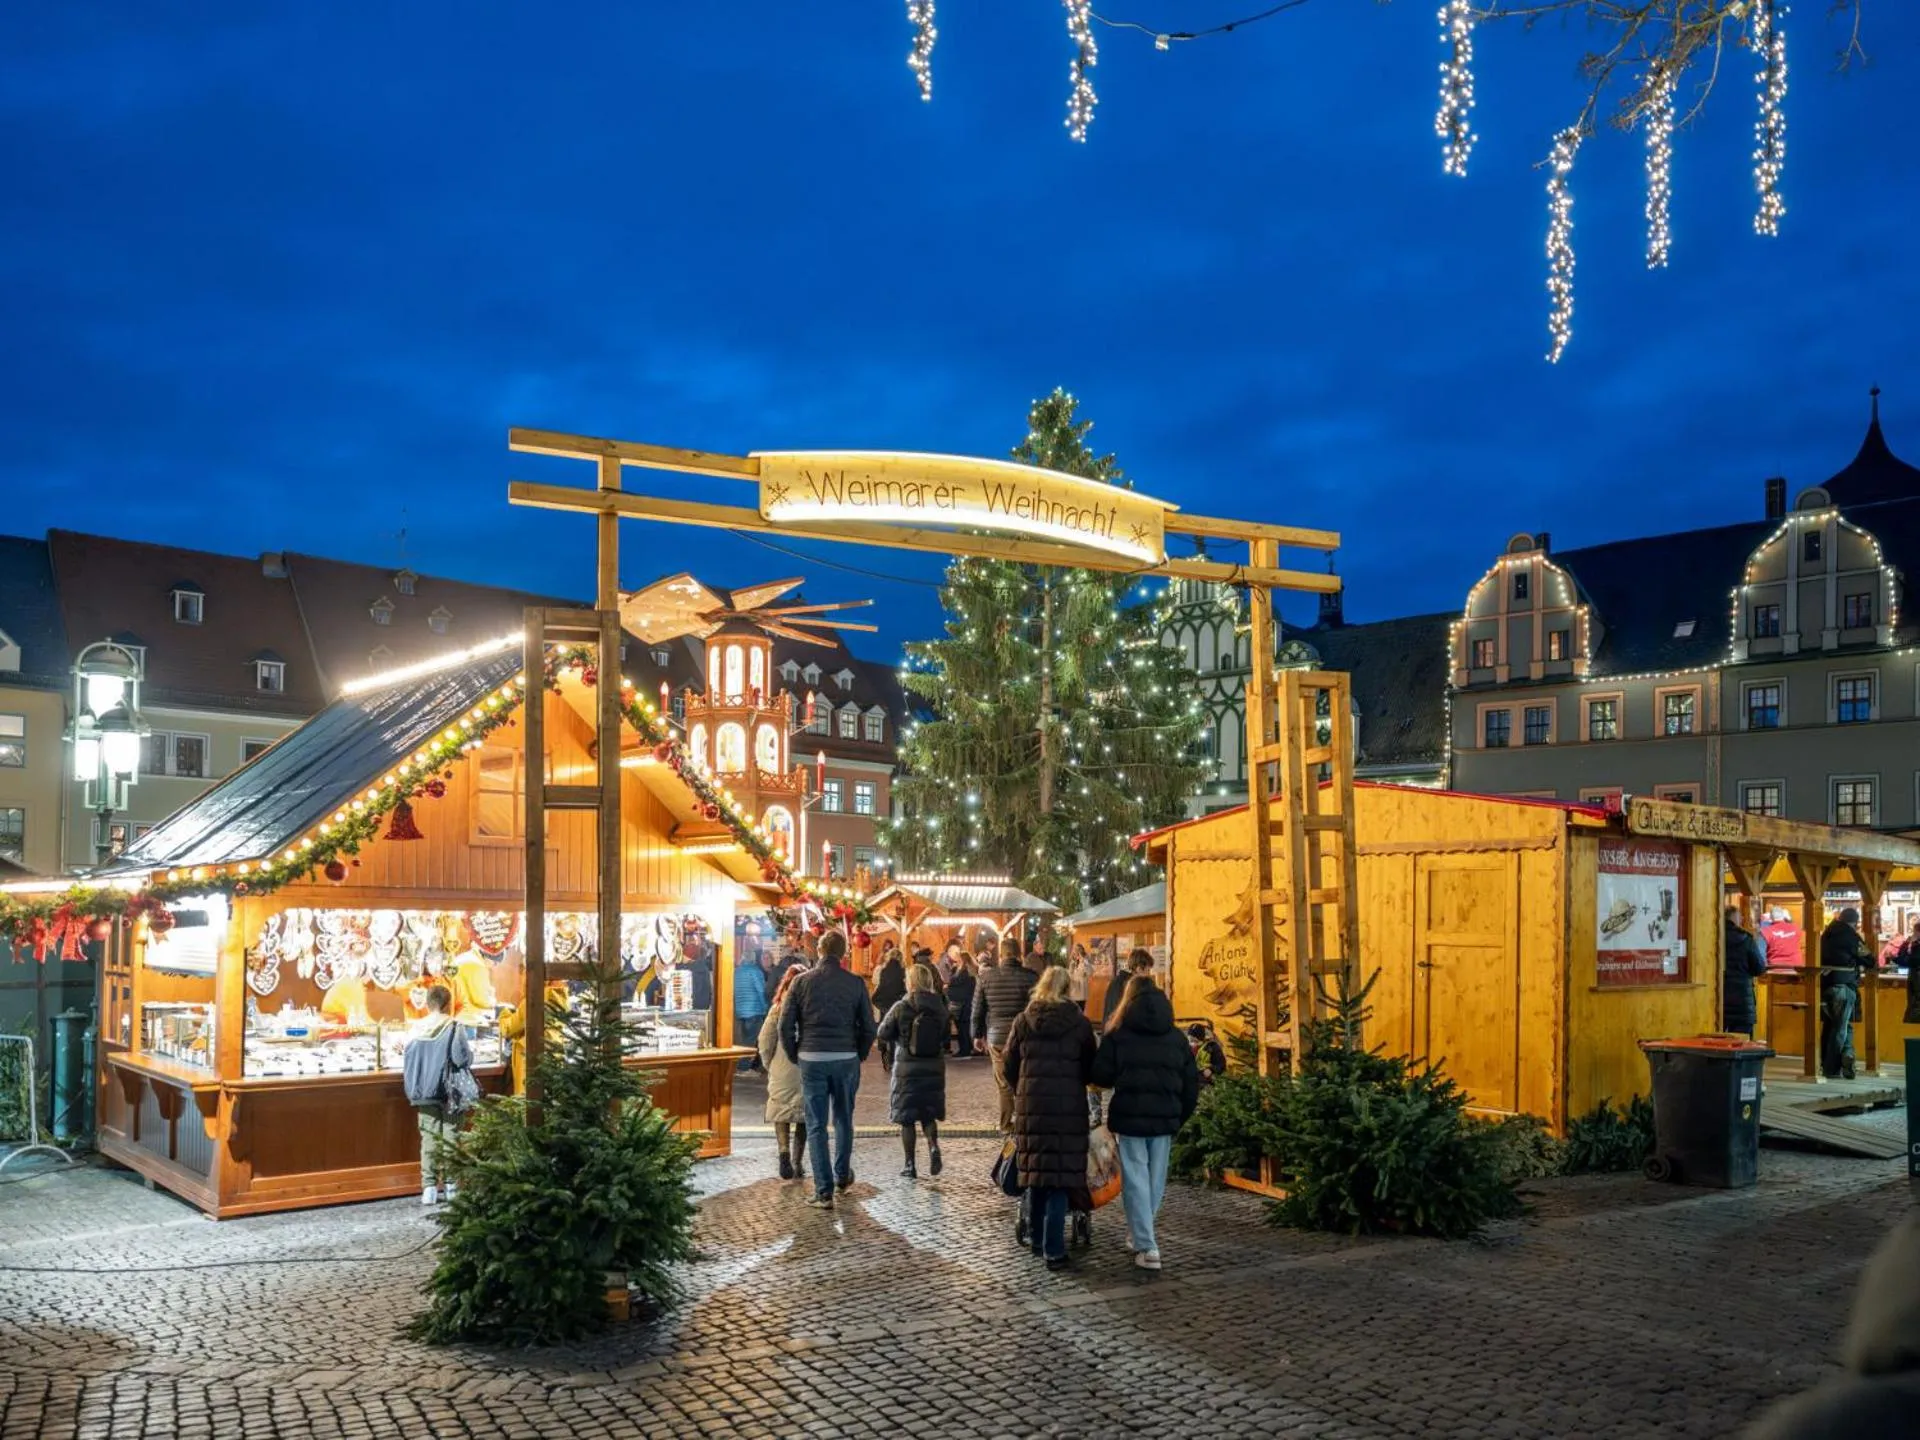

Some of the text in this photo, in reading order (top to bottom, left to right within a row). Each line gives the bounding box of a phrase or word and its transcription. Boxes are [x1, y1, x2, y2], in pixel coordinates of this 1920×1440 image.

[805, 470, 1117, 540] Weimarer Weihnacht
[1688, 808, 1698, 837] &
